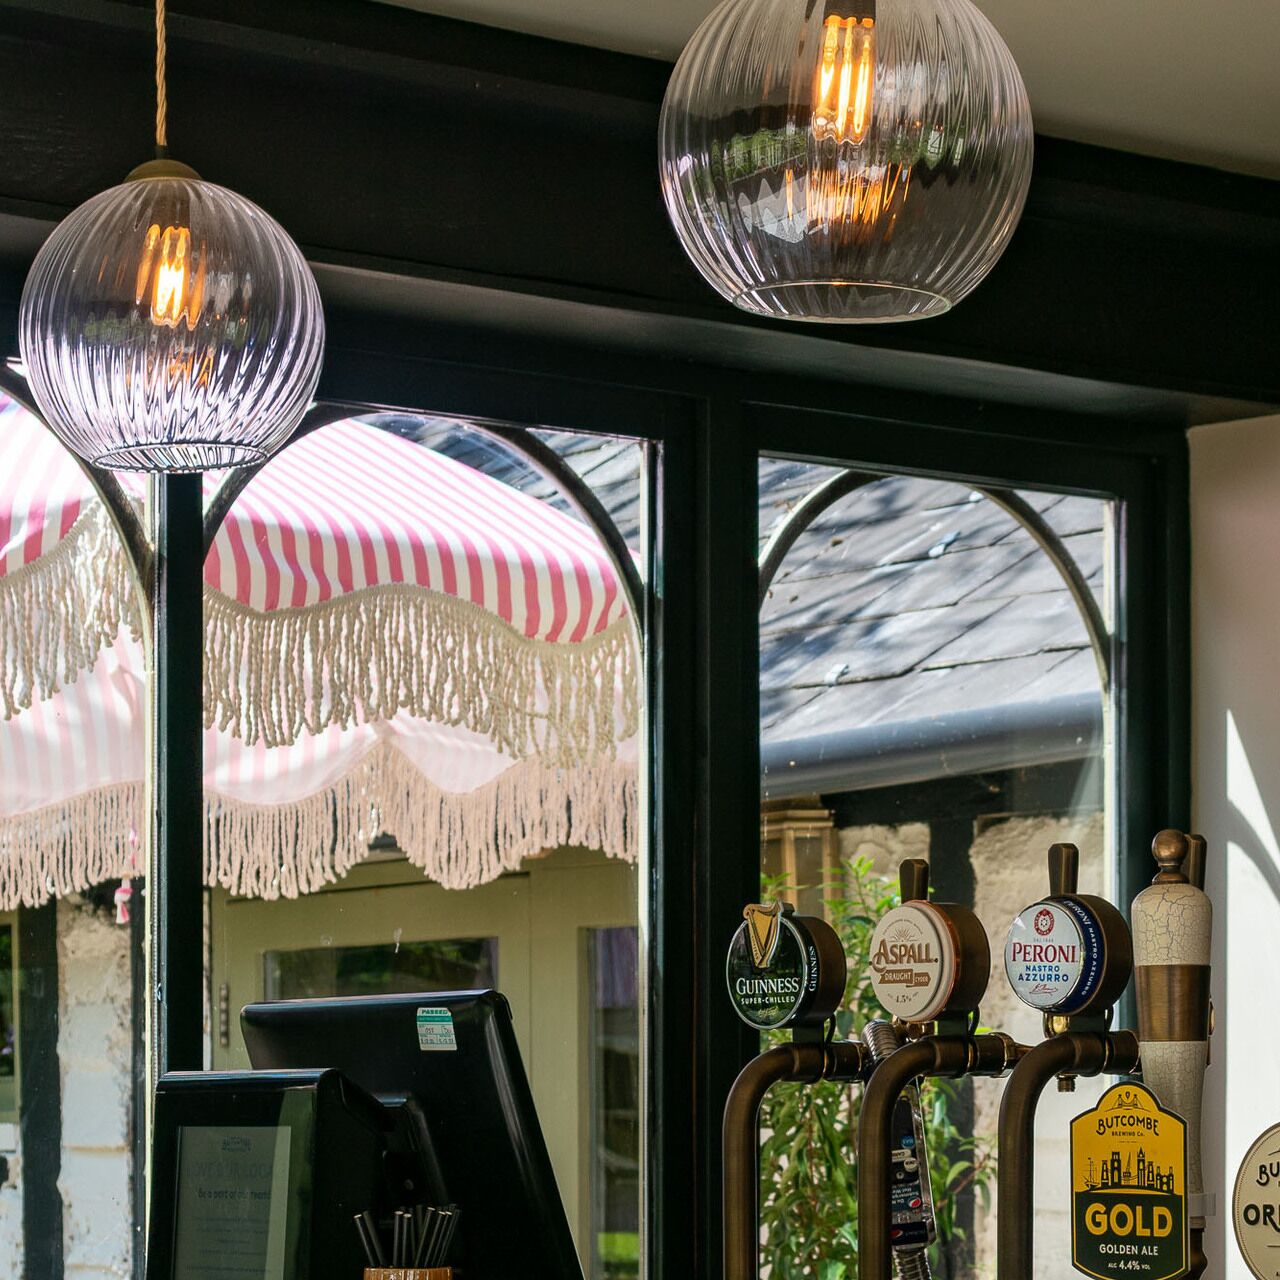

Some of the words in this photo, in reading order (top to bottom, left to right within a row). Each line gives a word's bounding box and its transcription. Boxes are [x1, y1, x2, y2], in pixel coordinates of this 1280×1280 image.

[1063, 900, 1092, 925] PERONI
[1011, 942, 1077, 963] PERONI
[808, 945, 818, 992] GUINNESS
[1025, 965, 1060, 973] NASTRO
[884, 972, 911, 981] DRAUGHT
[1018, 973, 1069, 983] AZZURRO
[736, 977, 800, 995] GUINNESS
[741, 995, 796, 1005] SUPER-CHILLED
[1096, 1115, 1160, 1136] BUTCOMBE
[1085, 1202, 1173, 1238] GOLD
[1099, 1243, 1138, 1255] GOLDEN
[1141, 1245, 1159, 1256] ALE
[1119, 1260, 1141, 1270] 4.4%
